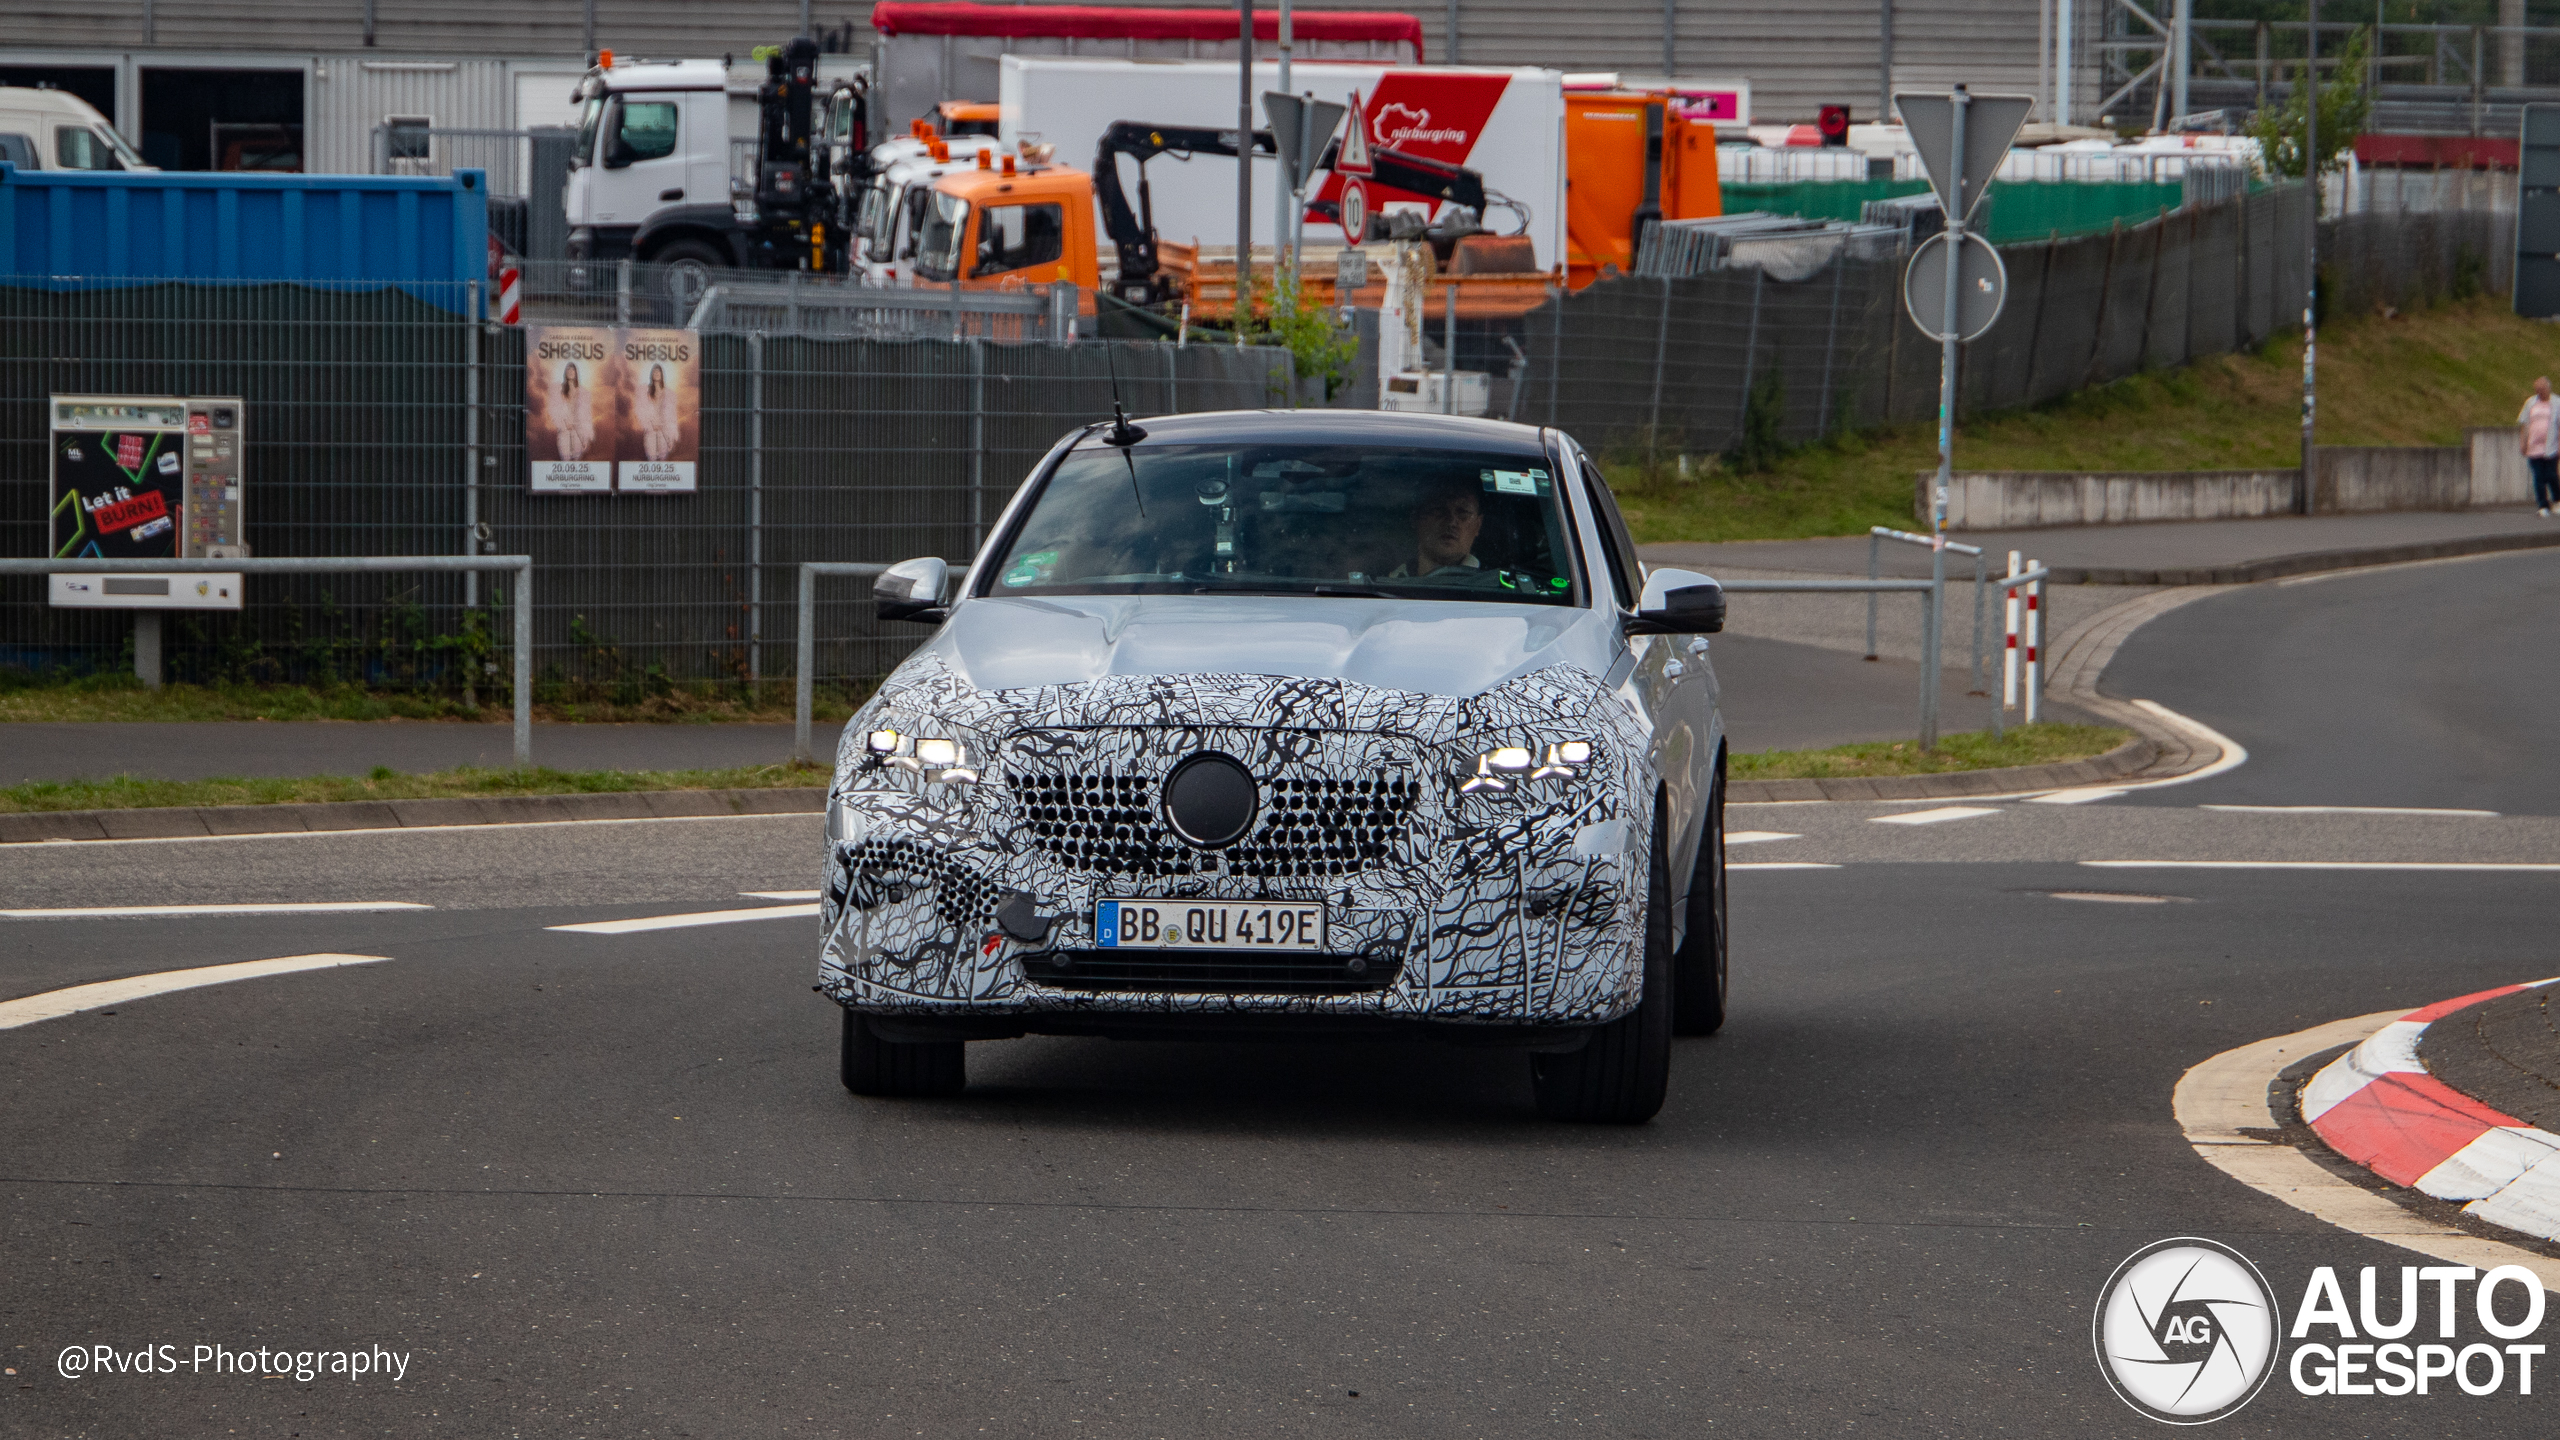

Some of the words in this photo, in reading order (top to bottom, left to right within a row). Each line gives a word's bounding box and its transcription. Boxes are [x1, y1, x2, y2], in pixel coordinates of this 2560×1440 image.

[1391, 127, 1467, 144] nürburgring
[1347, 198, 1360, 227] 10
[552, 463, 589, 473] 20.09.25
[638, 463, 675, 473] 20.09.25
[82, 492, 114, 512] Let
[114, 486, 132, 501] it
[101, 497, 160, 526] BURN!
[1103, 928, 1112, 939] D
[1120, 907, 1160, 942] BB
[1186, 908, 1227, 944] QU
[1235, 908, 1316, 945] 419E
